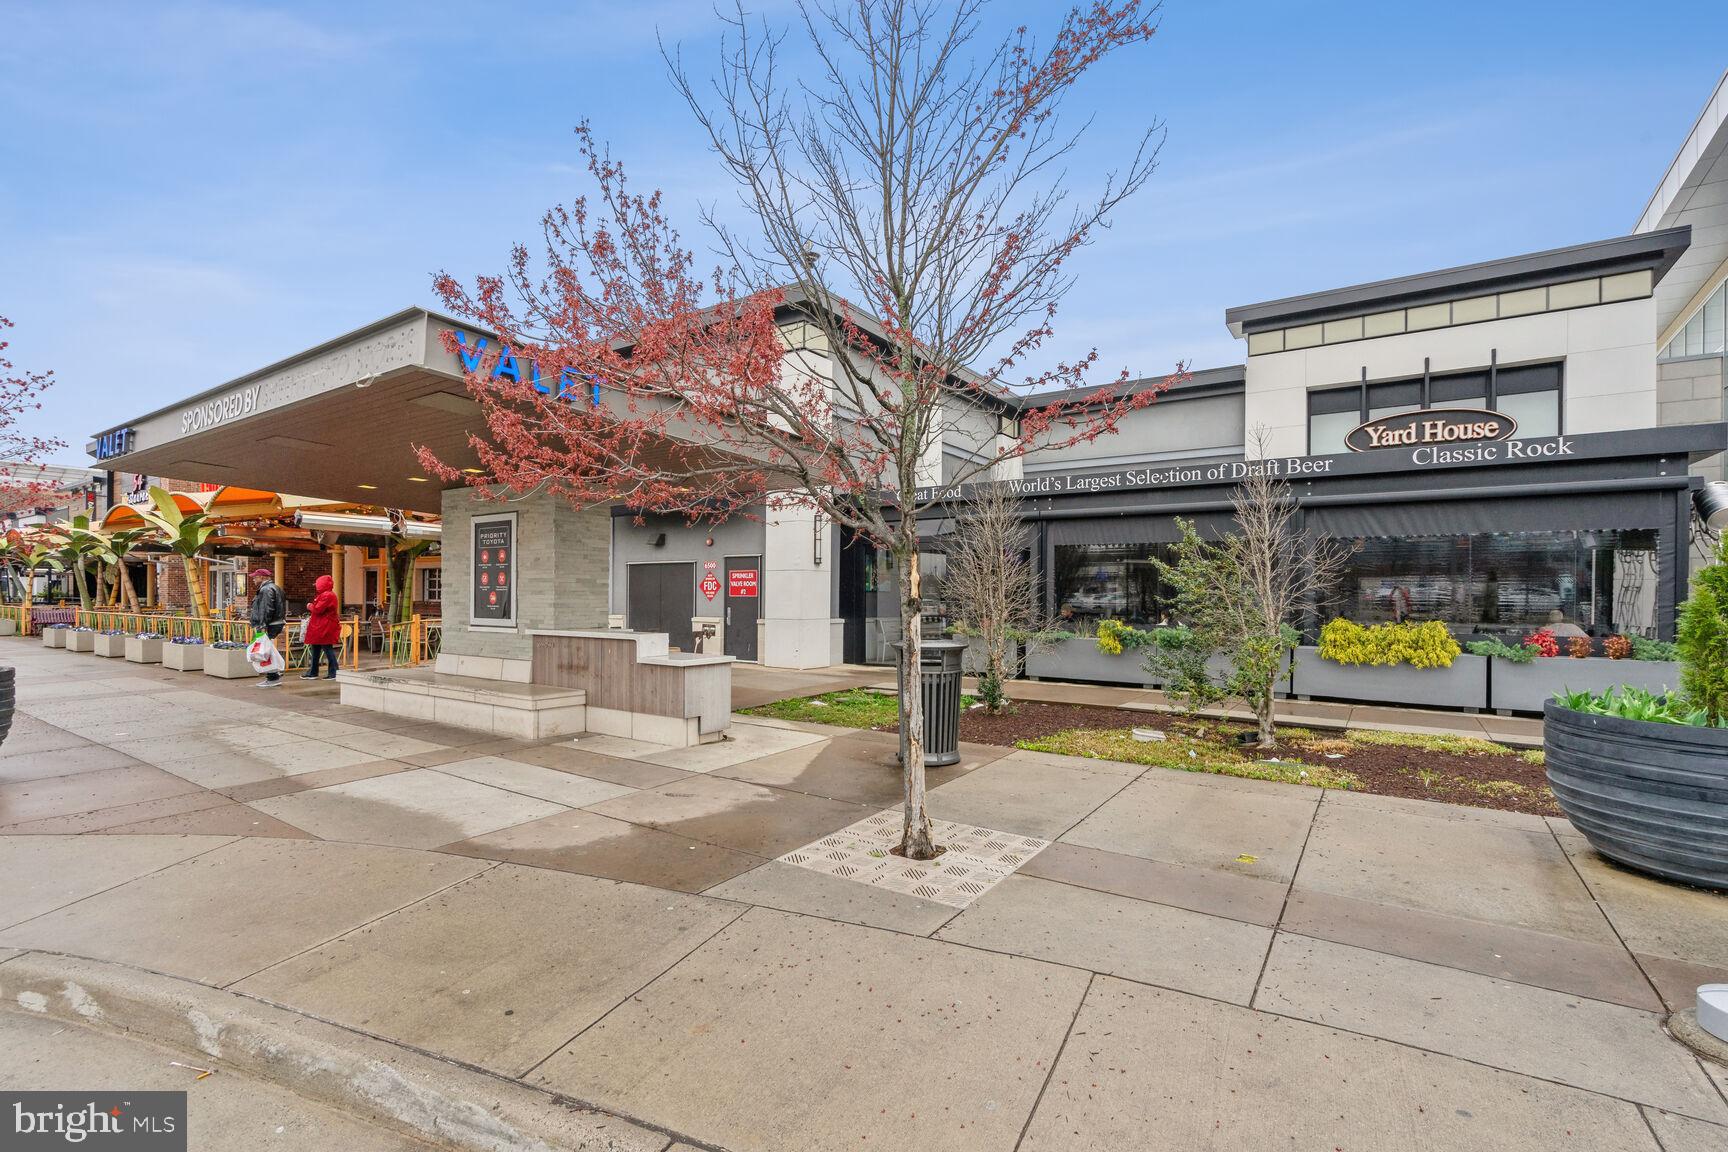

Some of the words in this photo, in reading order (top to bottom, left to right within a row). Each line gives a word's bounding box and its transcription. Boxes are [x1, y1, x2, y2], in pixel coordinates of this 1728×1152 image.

[455, 330, 608, 407] VALET
[182, 393, 243, 434] SPONSORED
[244, 384, 262, 413] BY
[95, 428, 129, 459] VALET
[1365, 422, 1417, 447] Yard
[1422, 420, 1500, 443] House
[1412, 443, 1497, 465] Classic
[1505, 437, 1575, 459] Rock
[1066, 475, 1122, 492] Largest
[1126, 467, 1202, 486] Selection
[1207, 463, 1228, 479] of
[1231, 460, 1280, 478] Draft
[1286, 458, 1334, 474] Beer
[931, 485, 962, 500] Food
[703, 581, 717, 591] FDC
